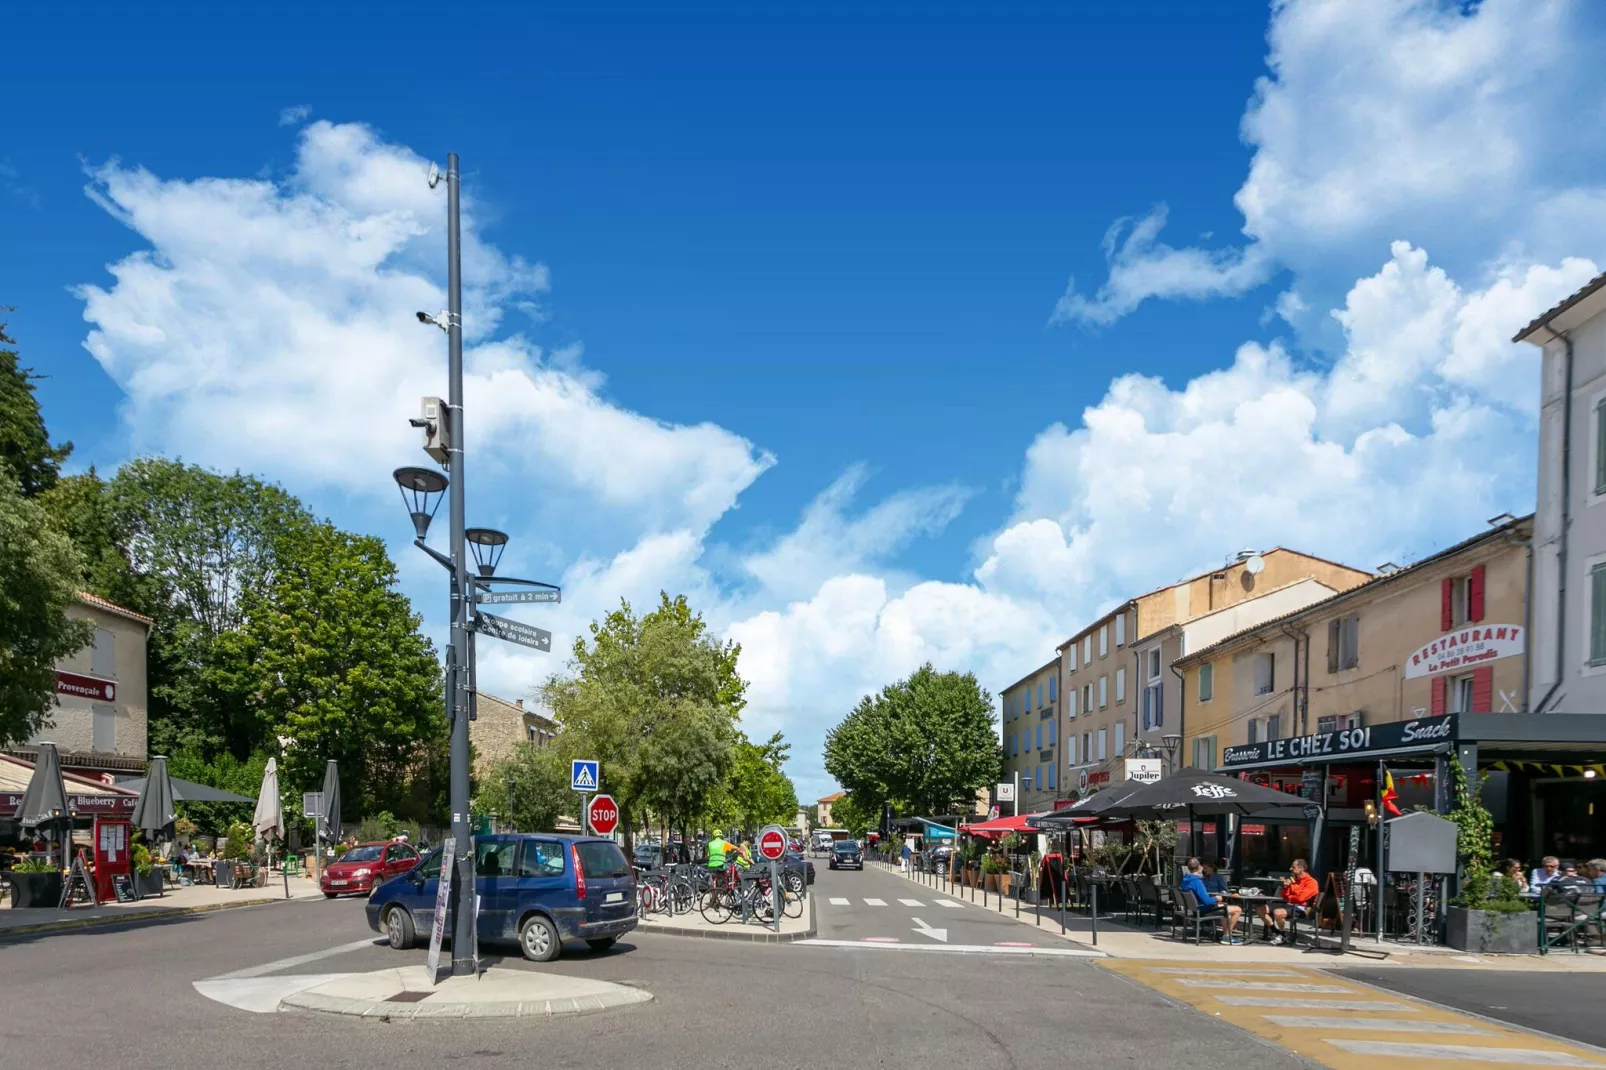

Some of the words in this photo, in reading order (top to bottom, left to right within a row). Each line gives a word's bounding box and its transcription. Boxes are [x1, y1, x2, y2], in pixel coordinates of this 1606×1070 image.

[493, 594, 518, 603] gratuit
[535, 592, 549, 600] min
[482, 615, 509, 629] Groupe
[510, 624, 537, 637] scolaire
[481, 624, 506, 636] Centre
[507, 632, 517, 640] de
[518, 634, 539, 646] loisirs
[1412, 627, 1519, 666] RESTAURANT
[1428, 663, 1438, 672] Le
[1440, 656, 1460, 669] Petit
[1462, 648, 1498, 664] Paradis
[58, 680, 101, 696] Provençale
[1224, 747, 1261, 762] Brasserie
[1267, 741, 1285, 759] LE
[1339, 726, 1371, 750] SOI
[1401, 716, 1452, 742] Snack
[1129, 771, 1160, 780] Jupiler
[1191, 785, 1233, 798] Leffe
[77, 797, 117, 808] Blueberry
[592, 809, 616, 821] STOP
